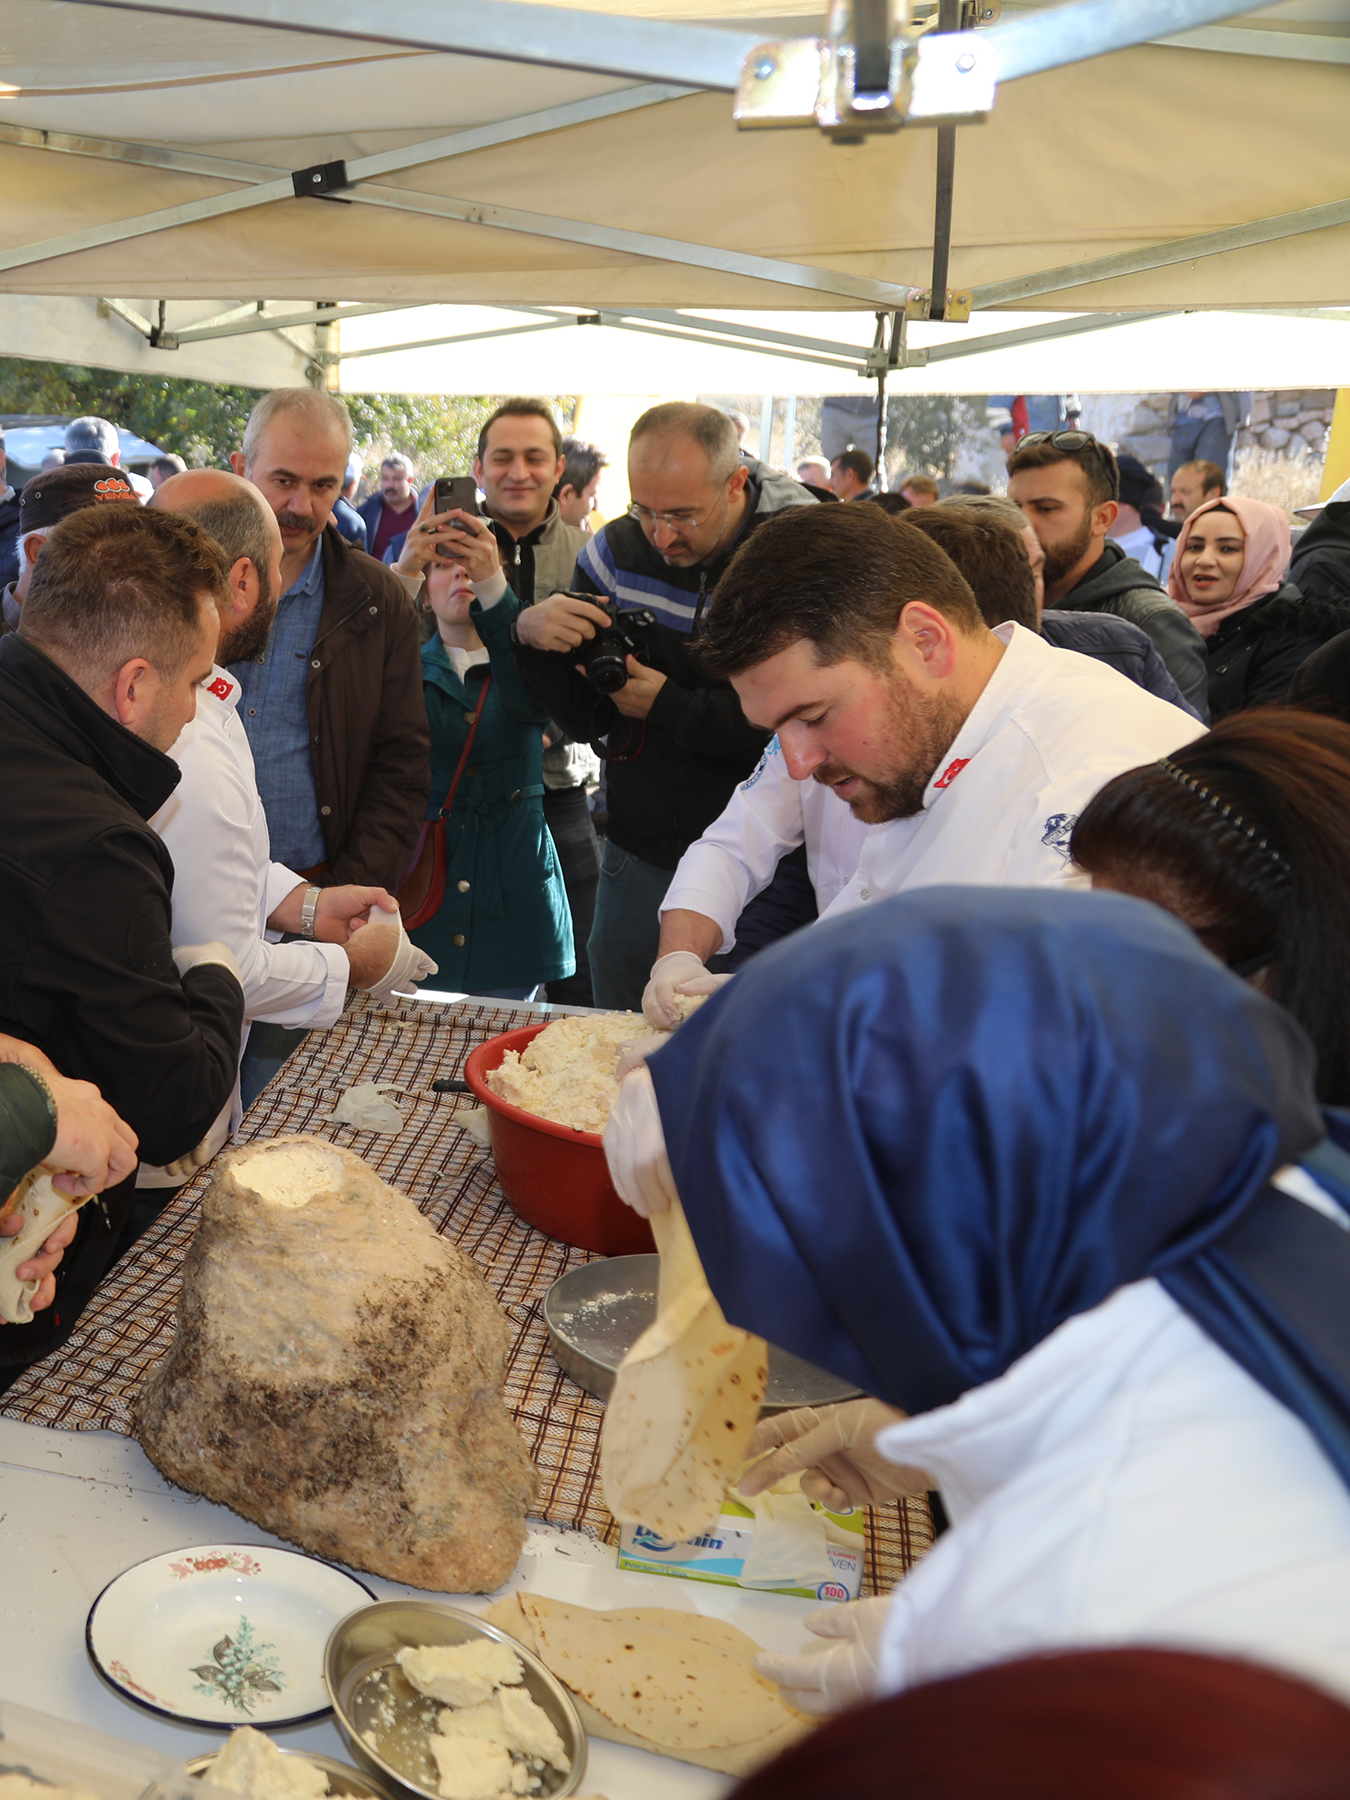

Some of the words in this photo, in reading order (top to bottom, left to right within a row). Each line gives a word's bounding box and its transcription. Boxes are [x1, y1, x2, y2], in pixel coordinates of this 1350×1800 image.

[1043, 828, 1067, 846] WORLD
[624, 1561, 664, 1574] Powdered
[666, 1568, 688, 1578] Latex
[825, 1586, 844, 1598] 100
